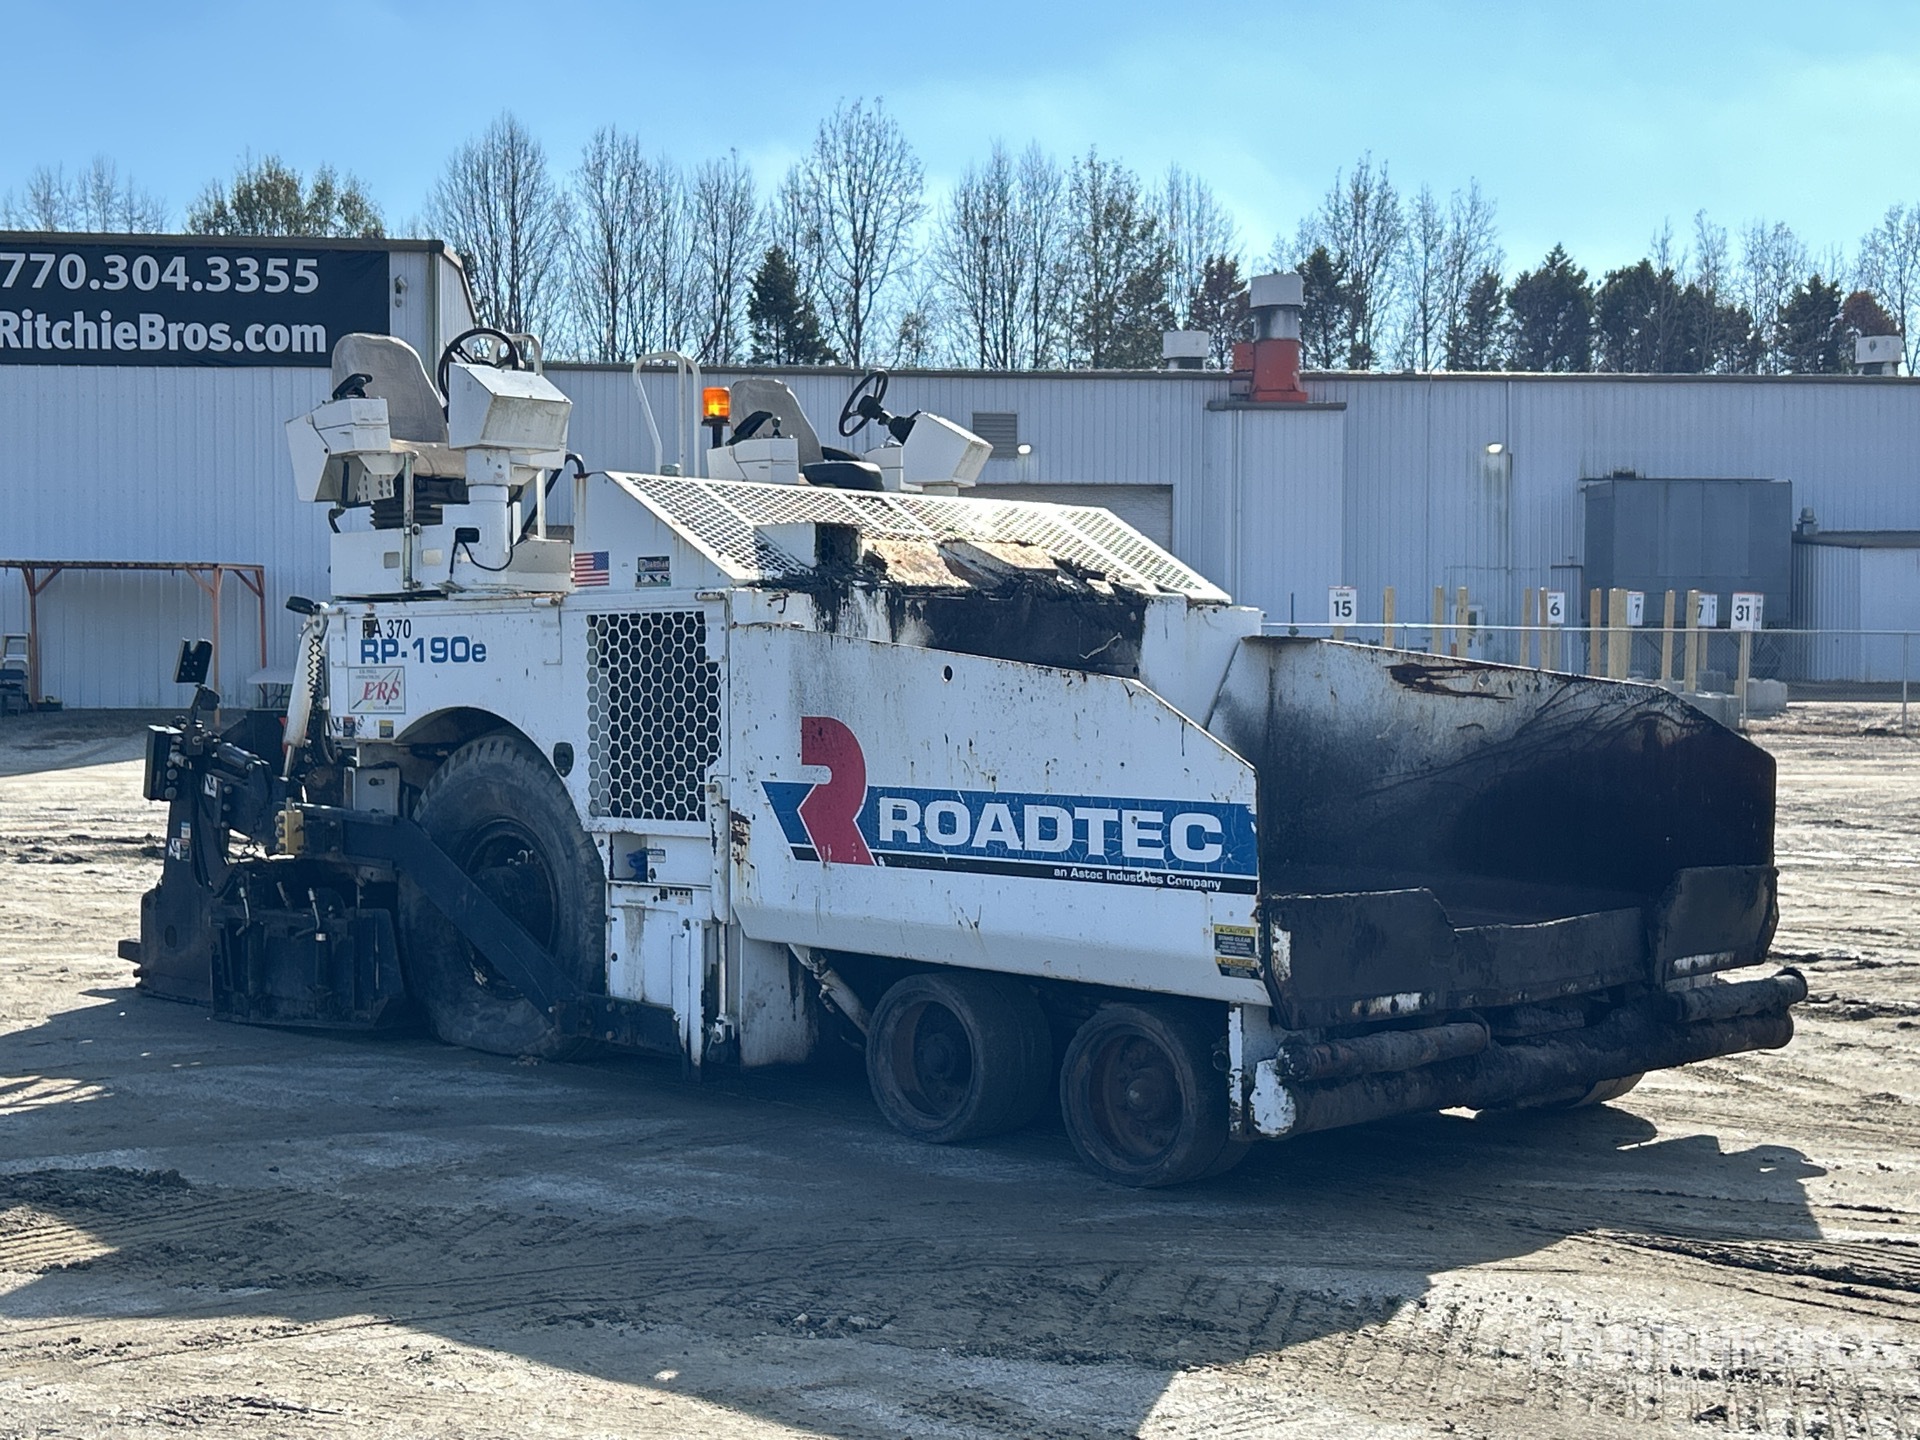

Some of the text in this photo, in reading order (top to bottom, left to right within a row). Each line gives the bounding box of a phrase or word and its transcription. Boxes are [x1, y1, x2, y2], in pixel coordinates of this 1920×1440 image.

[0, 252, 320, 294] 770.304.3355
[0, 308, 327, 353] RitchieBros.com
[1333, 600, 1352, 617] 15
[1550, 602, 1561, 616] 6
[1735, 605, 1750, 621] 31
[386, 619, 412, 639] 370
[360, 636, 487, 664] RP-190e
[363, 680, 401, 700] ERS
[879, 797, 1223, 863] ROADTEC
[1053, 868, 1067, 877] an
[1070, 867, 1103, 880] Astec
[1166, 874, 1222, 891] Company
